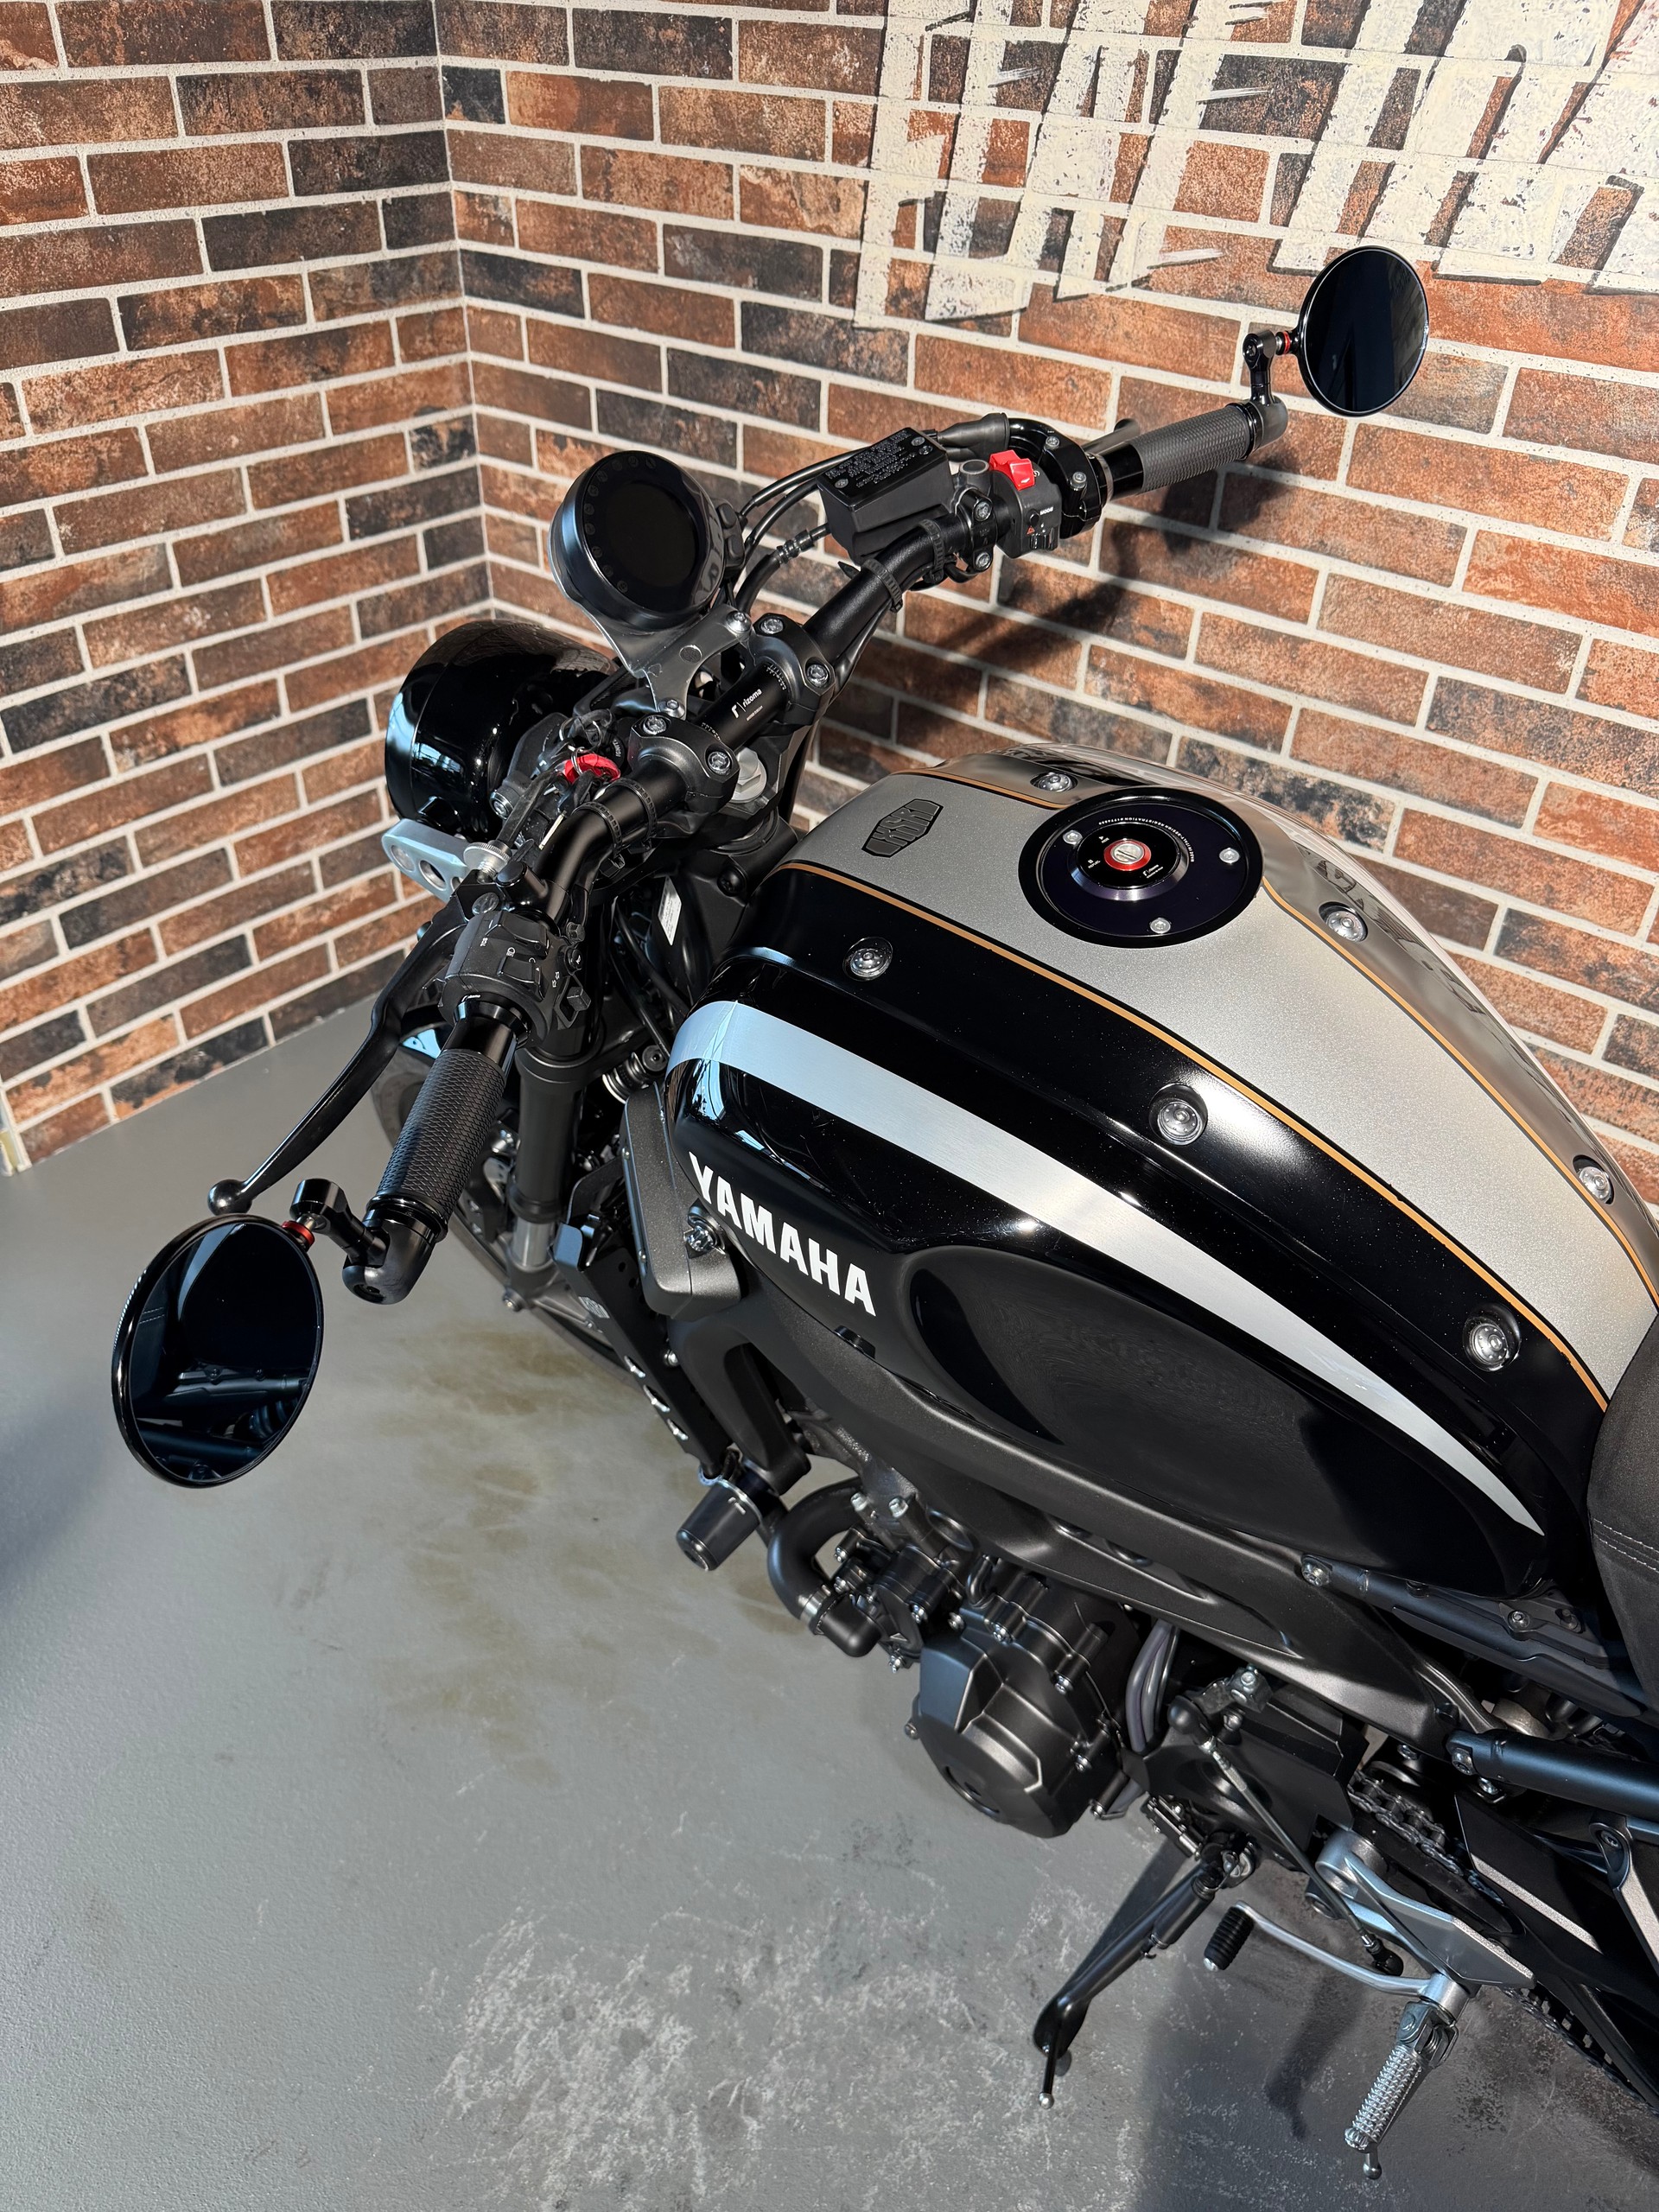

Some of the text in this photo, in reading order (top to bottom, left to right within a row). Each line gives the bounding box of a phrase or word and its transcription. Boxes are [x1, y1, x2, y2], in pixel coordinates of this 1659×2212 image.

[742, 689, 762, 708] rizoma
[480, 938, 488, 947] TCS
[689, 1151, 876, 1317] YAMAHA
